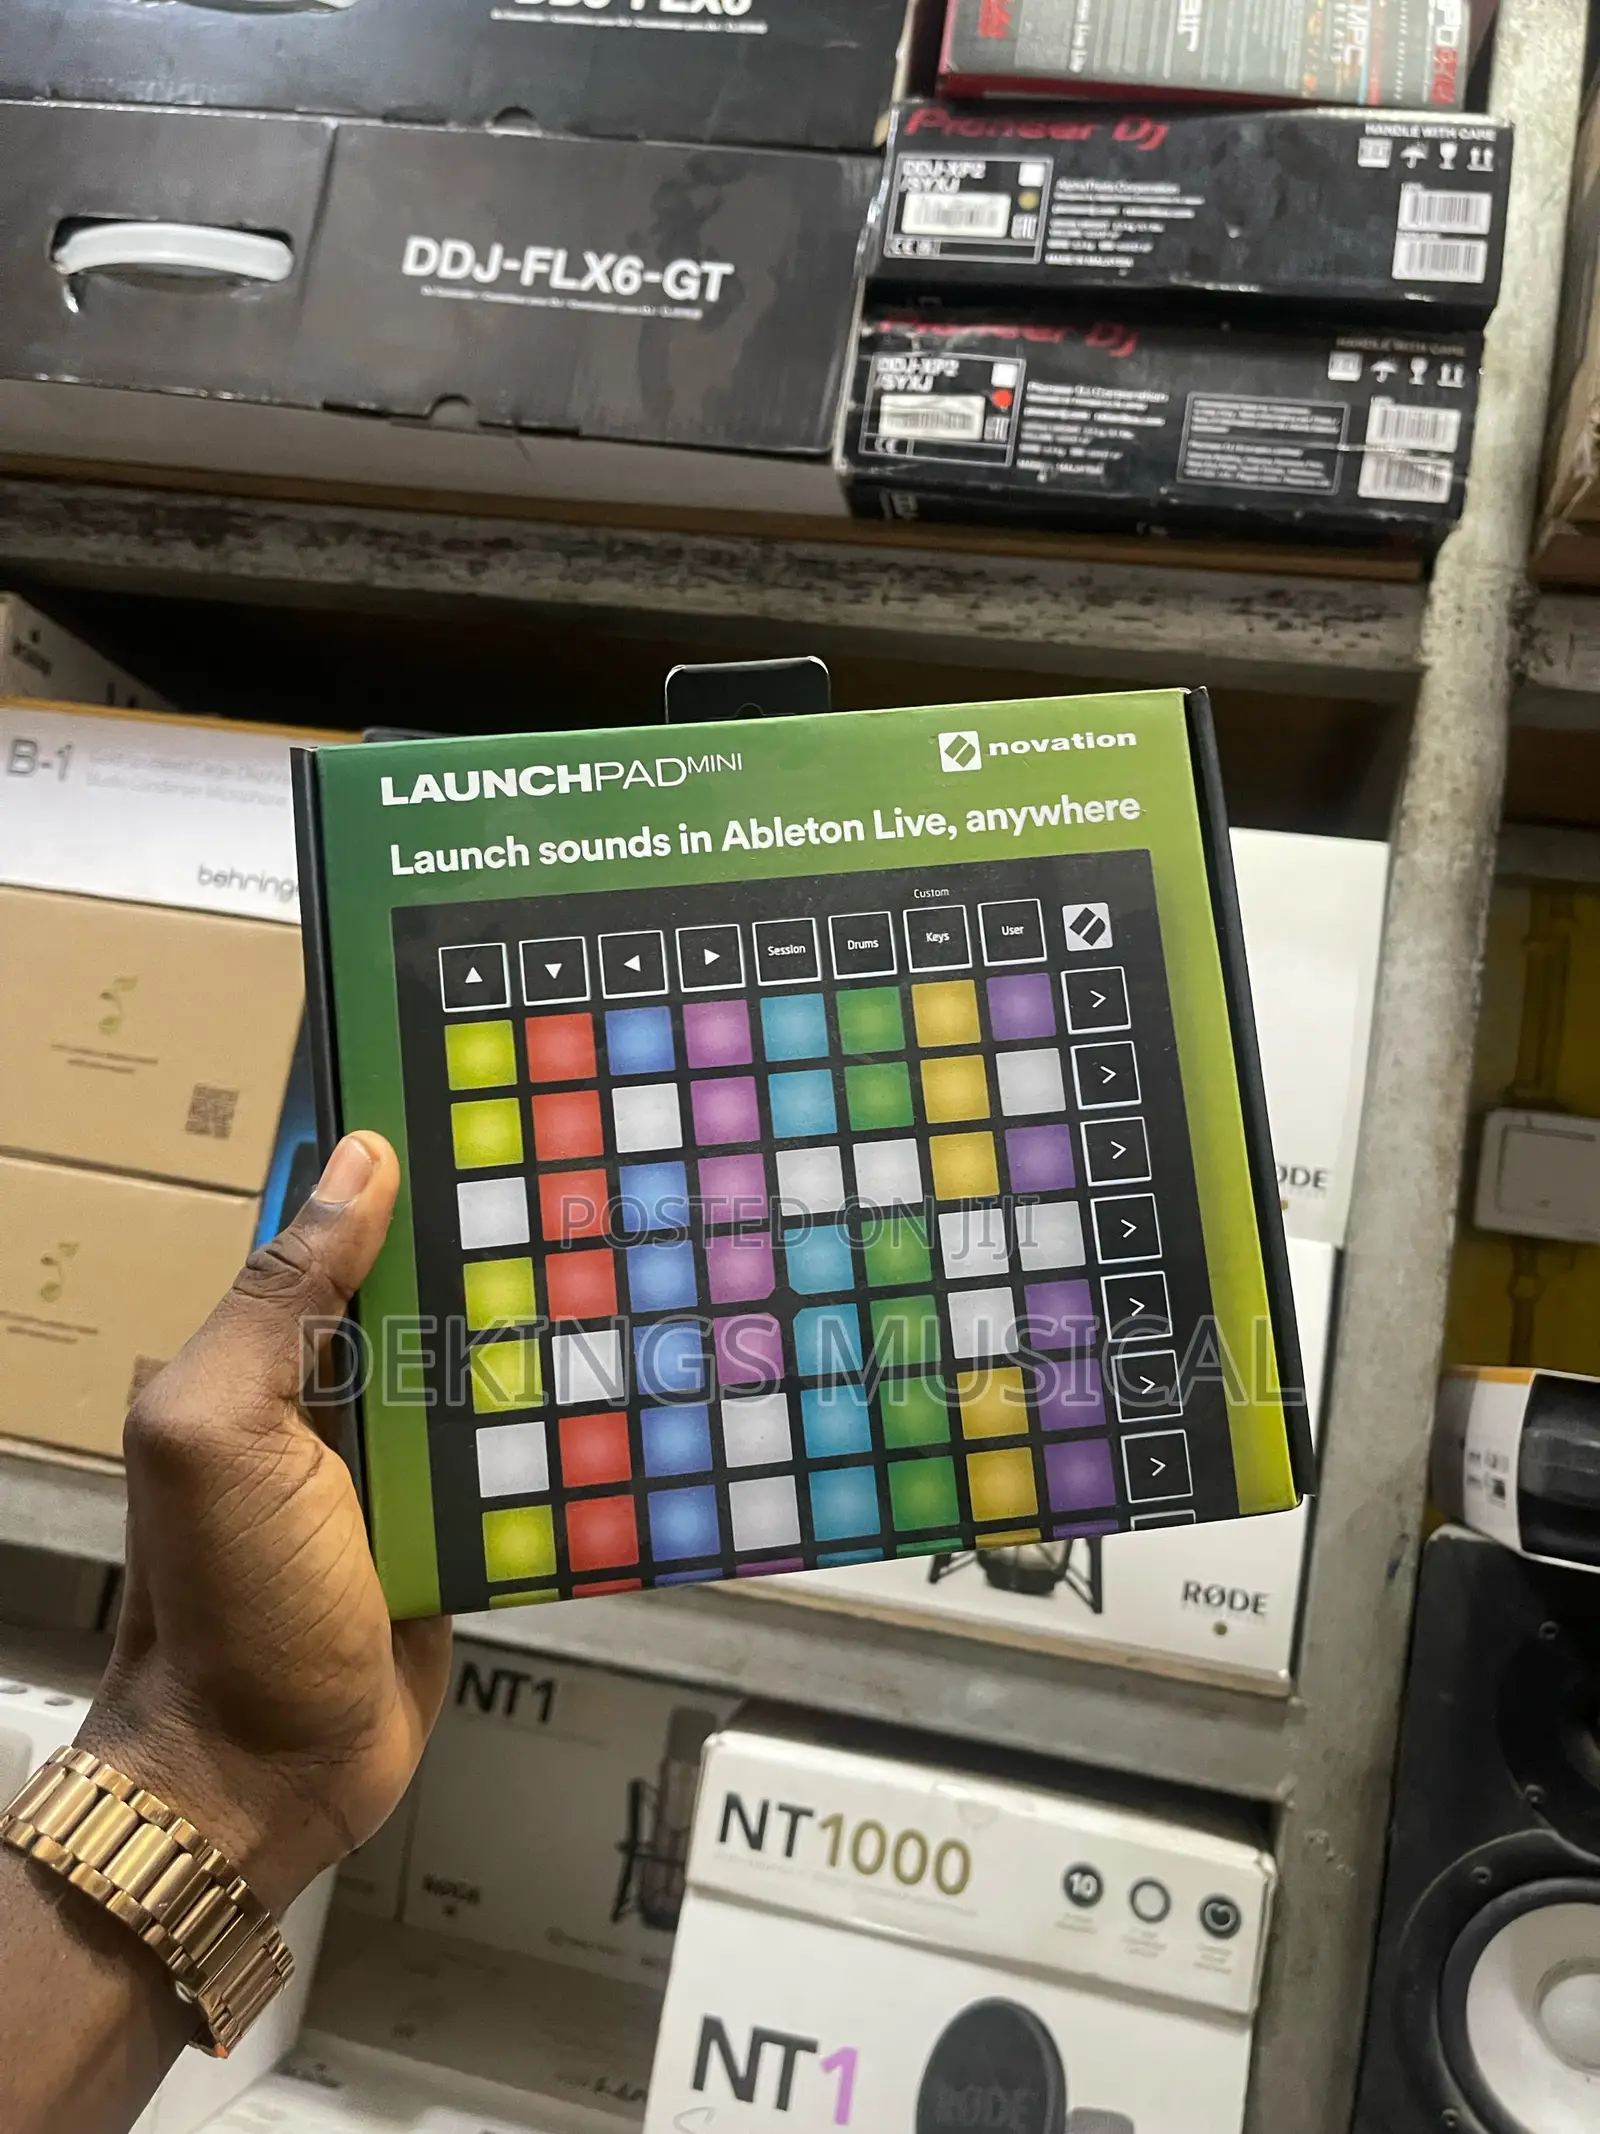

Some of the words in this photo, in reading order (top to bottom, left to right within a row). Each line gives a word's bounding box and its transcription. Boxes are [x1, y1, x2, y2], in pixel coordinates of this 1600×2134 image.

[904, 107, 1097, 140] Pioneer
[402, 234, 734, 302] DDJ-FLX6-GT
[6, 737, 76, 782] B-1
[988, 731, 1138, 757] novation
[390, 835, 530, 876] Launch
[539, 826, 672, 865] sounds
[678, 824, 713, 855] in
[722, 816, 864, 852] Ableton
[872, 807, 957, 841] Live,
[966, 794, 1141, 837] anywhere
[198, 863, 300, 903] behring
[913, 886, 950, 899] Custom
[847, 937, 879, 951] Drums
[925, 931, 950, 945] Keys
[1001, 924, 1025, 937] User
[767, 943, 806, 957] Session
[1182, 1578, 1270, 1616] RØDE
[455, 1660, 560, 1724] NT1
[717, 1790, 973, 1896] NT1000
[1068, 1871, 1099, 1898] 10
[691, 2012, 859, 2127] NT1
